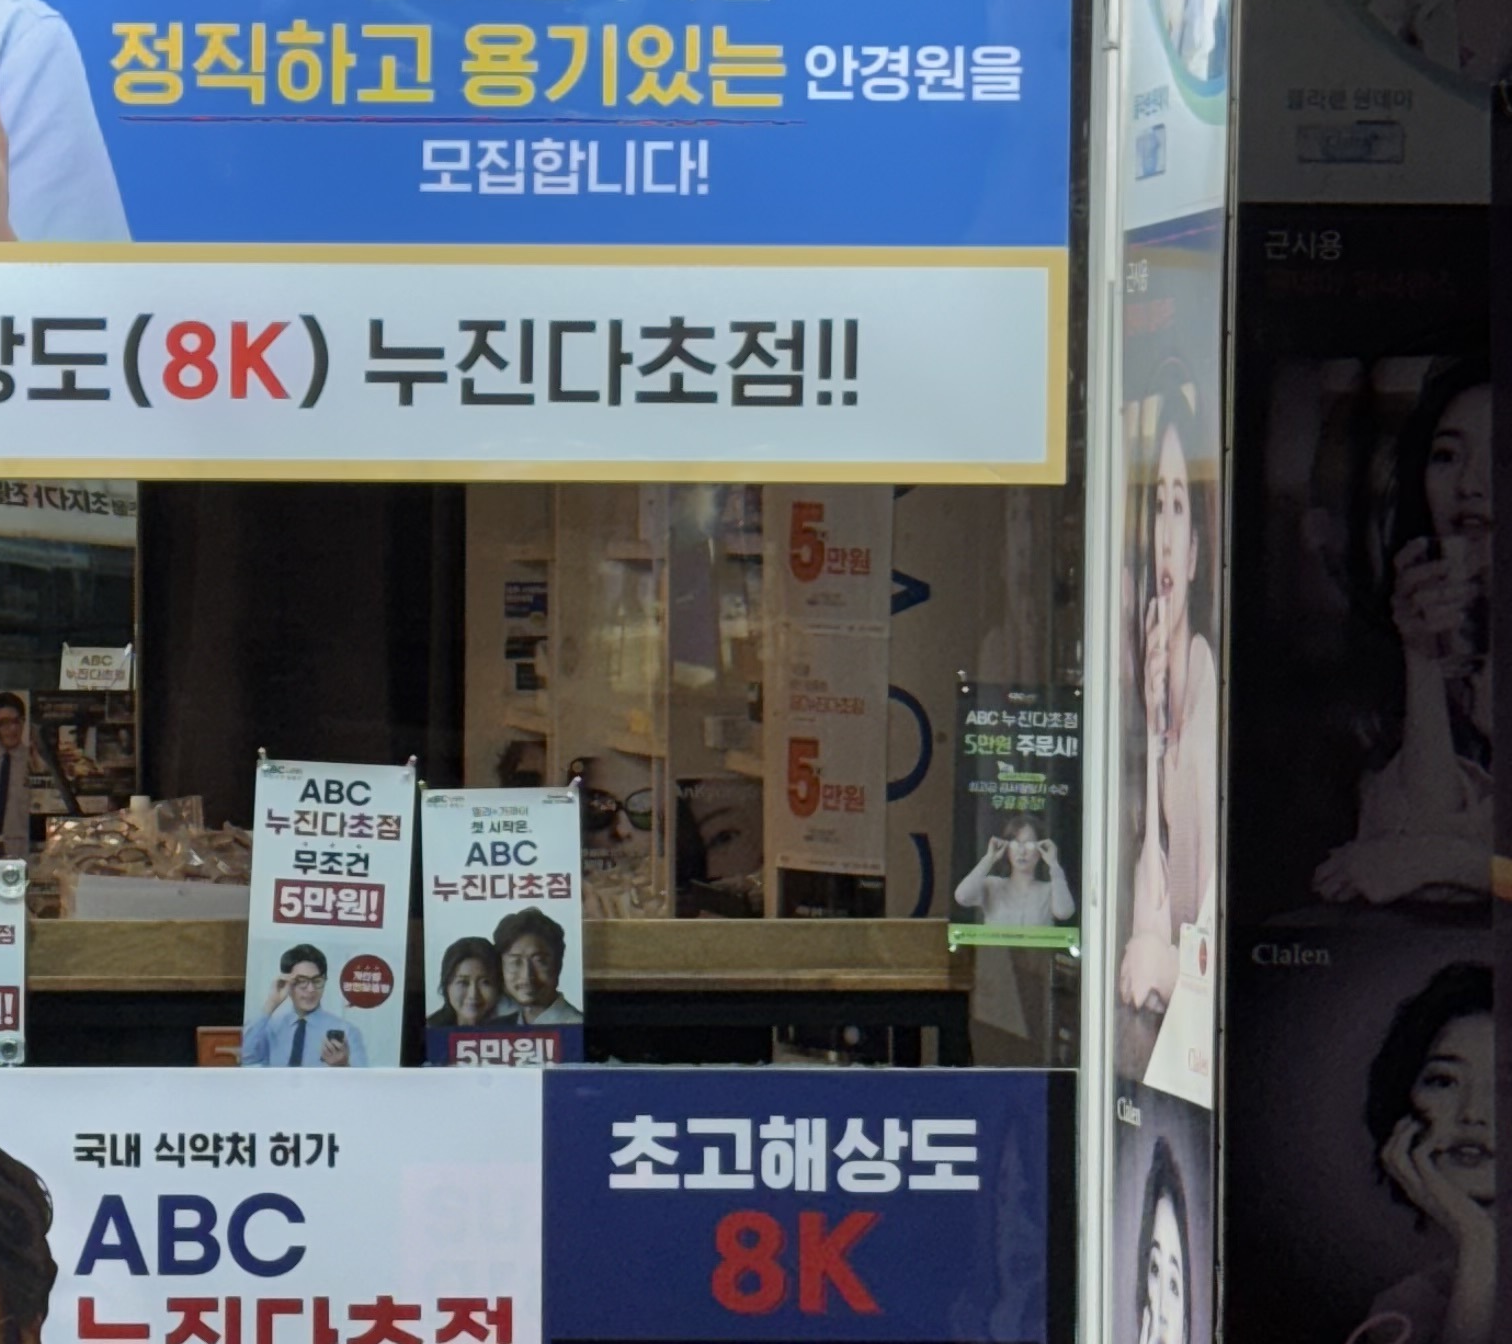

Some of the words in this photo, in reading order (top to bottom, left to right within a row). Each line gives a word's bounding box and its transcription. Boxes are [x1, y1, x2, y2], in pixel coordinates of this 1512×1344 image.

[109, 20, 435, 108] 정직하고
[461, 21, 786, 109] 용기있는
[804, 43, 1024, 104] 안경원을
[419, 138, 710, 198] 모집합니다!
[1263, 230, 1344, 261] 근시용
[363, 315, 860, 409] 누진다초점!!
[80, 654, 114, 668] ABC
[965, 710, 999, 727] ABC
[1001, 710, 1078, 729] 누진다초점
[963, 735, 1012, 756] 5만원
[1015, 735, 1078, 757] 주문시!
[299, 778, 372, 806] ABC
[264, 808, 402, 841] 누진다초점
[292, 848, 370, 877] 무조건
[464, 840, 539, 867] ABC
[432, 872, 573, 902] 누진다초점
[278, 885, 380, 924] 5만원!
[1250, 942, 1332, 967] Clalen
[455, 1036, 556, 1067] 5만원!
[1116, 1095, 1142, 1128] Clalen
[72, 1132, 143, 1170] 국내
[152, 1132, 260, 1170] 식약처
[269, 1131, 340, 1170] 허가
[607, 1115, 980, 1195] 초고해상도
[73, 1192, 307, 1278] ABC
[709, 1210, 883, 1317] 8K
